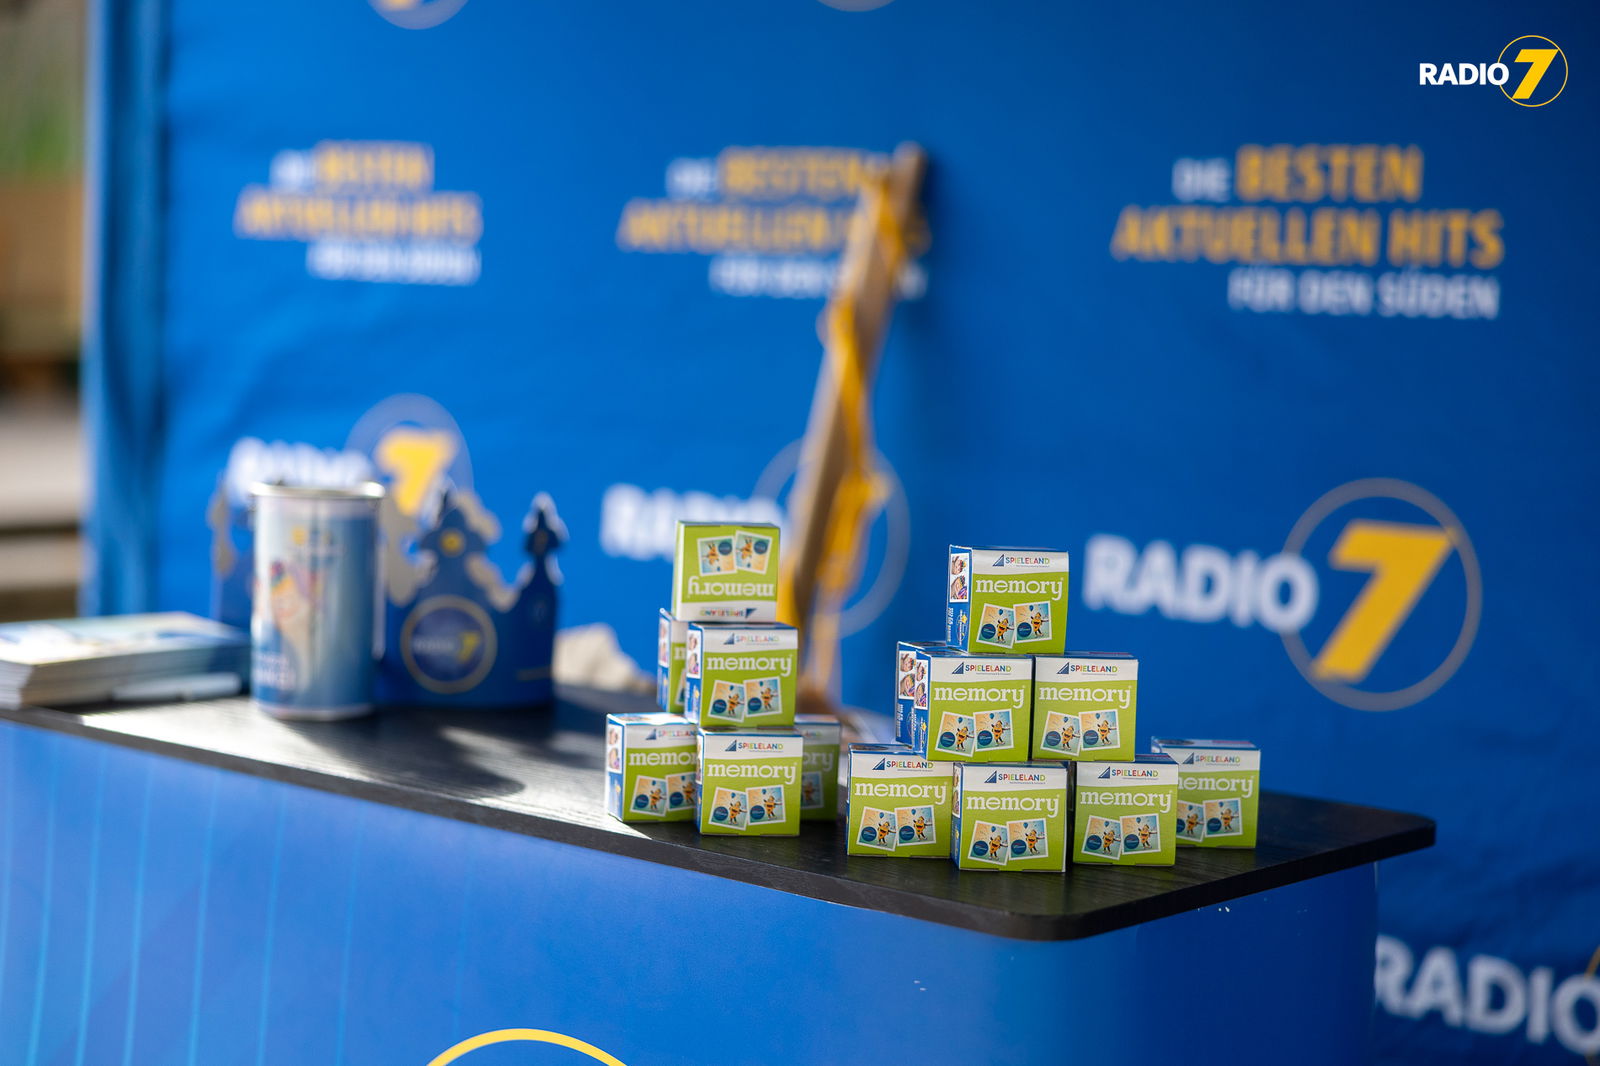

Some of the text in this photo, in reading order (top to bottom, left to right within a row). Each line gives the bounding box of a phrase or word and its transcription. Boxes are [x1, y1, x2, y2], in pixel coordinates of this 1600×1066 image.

[1235, 143, 1424, 203] BESTEN
[1110, 205, 1505, 269] AKTUELLEN HITS
[1298, 269, 1374, 316] DEN
[1005, 556, 1050, 566] SPIELELAND
[687, 576, 775, 598] memory
[975, 578, 1064, 600] memory
[1084, 519, 1457, 680] RADIO 7
[735, 635, 779, 643] SPIELELAND
[706, 654, 793, 677] memory
[965, 664, 1012, 673] SPIELELAND
[1070, 664, 1118, 673] SPIELELAND
[934, 685, 1025, 709] memory
[1039, 685, 1132, 709] memory
[738, 742, 783, 750] SPIELELAND
[886, 760, 934, 769] SPIELELAND
[1196, 755, 1241, 764] SPIELELAND
[707, 762, 797, 785] memory
[998, 773, 1045, 782] SPIELELAND
[1111, 769, 1158, 778] SPIELELAND
[854, 781, 947, 805] memory
[1080, 790, 1172, 814] memory
[966, 794, 1060, 818] memory
[1374, 933, 1600, 1056] RADIO
